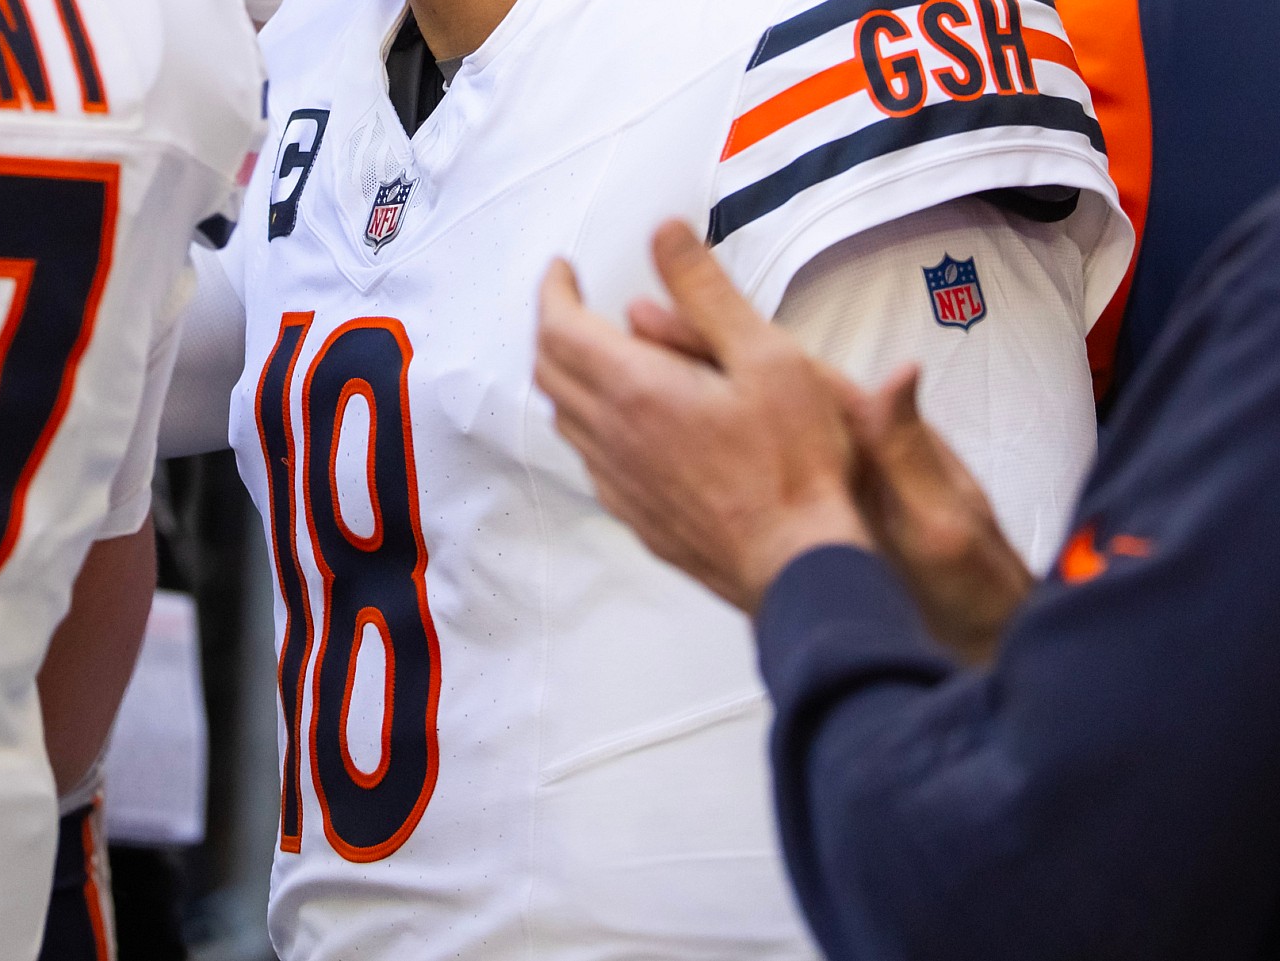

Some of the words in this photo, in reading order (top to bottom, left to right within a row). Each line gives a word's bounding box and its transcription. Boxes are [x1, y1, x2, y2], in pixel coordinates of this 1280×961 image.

[271, 118, 319, 205] C
[369, 206, 399, 238] NFL
[934, 285, 982, 321] NFL
[255, 310, 441, 864] 18
